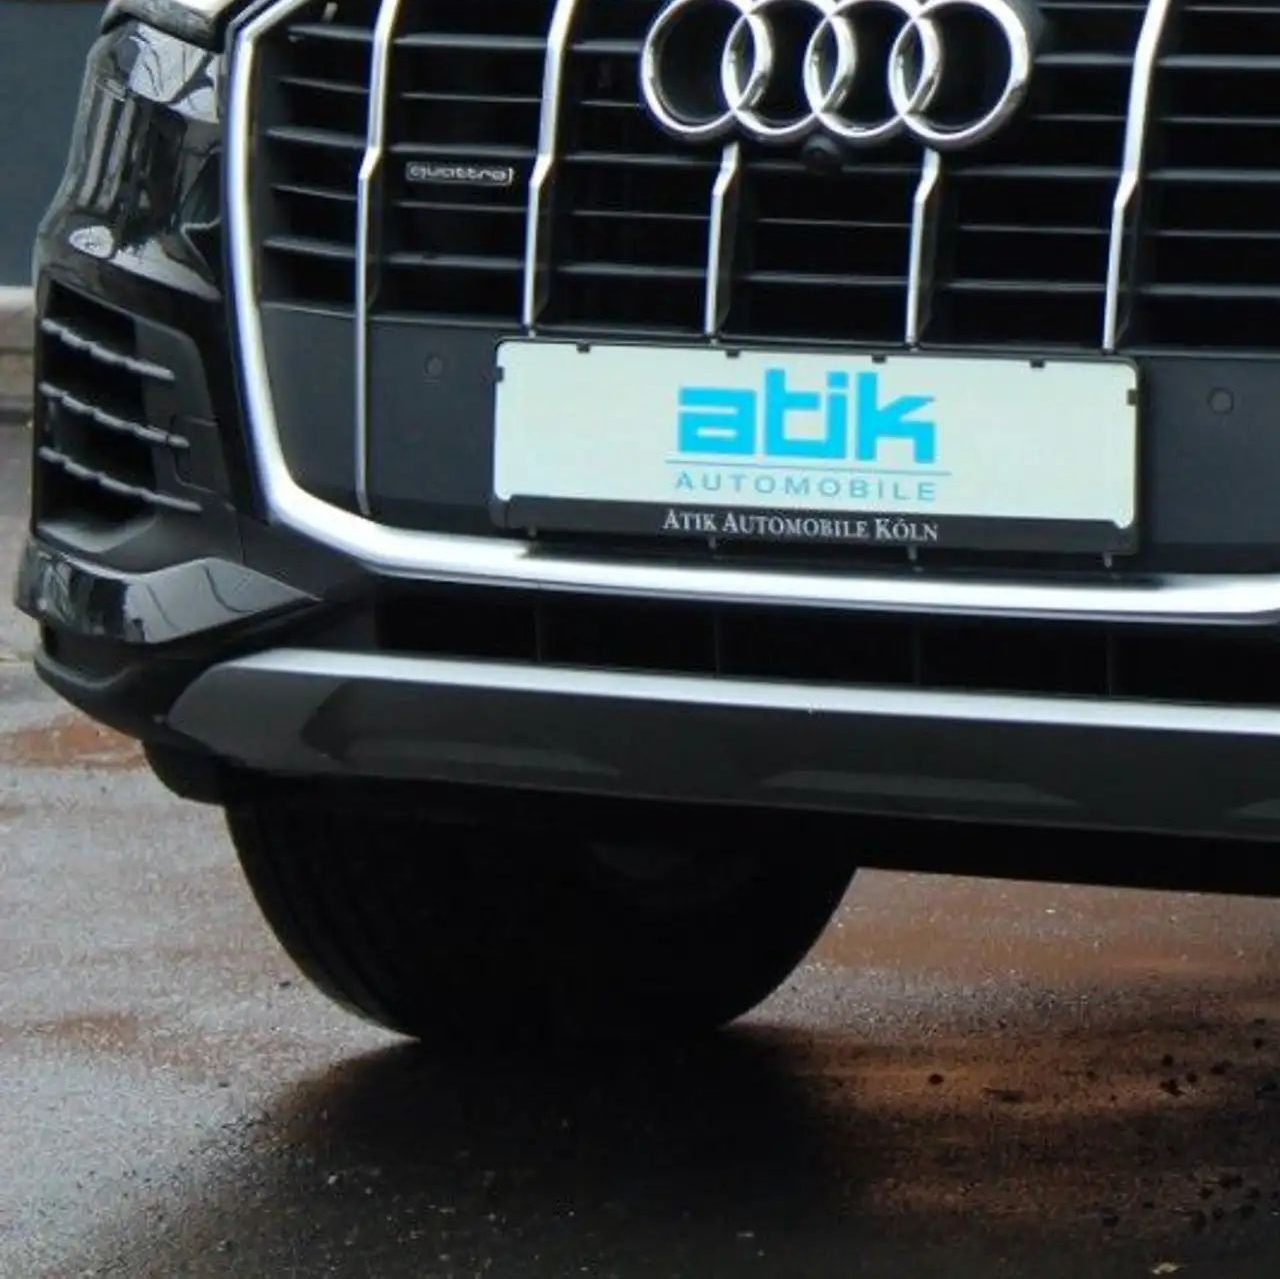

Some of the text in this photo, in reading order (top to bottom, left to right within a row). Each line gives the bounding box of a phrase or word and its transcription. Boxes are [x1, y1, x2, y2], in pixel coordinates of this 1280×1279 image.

[409, 165, 508, 182] quattro
[677, 368, 937, 465] atik
[675, 472, 936, 502] AUTOMOBILE
[662, 509, 717, 532] ATIK
[722, 511, 869, 539] AUTOMOBILE
